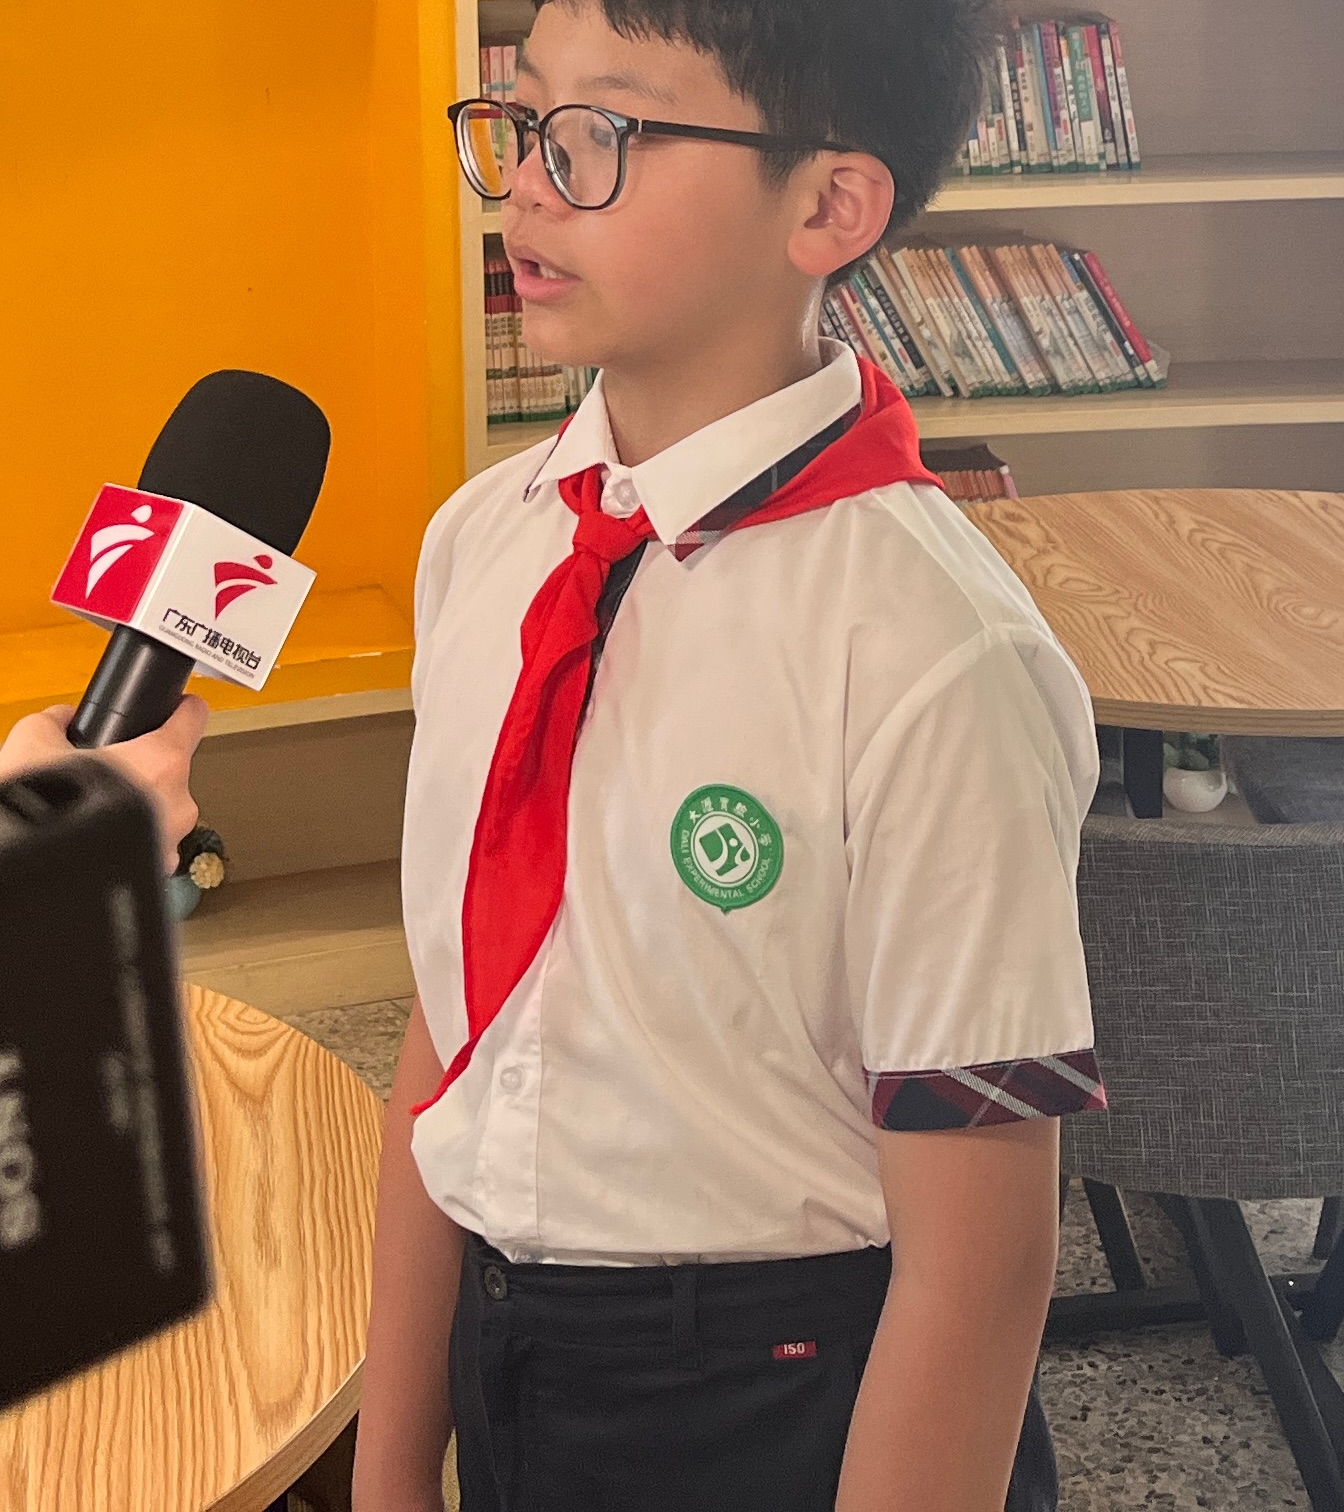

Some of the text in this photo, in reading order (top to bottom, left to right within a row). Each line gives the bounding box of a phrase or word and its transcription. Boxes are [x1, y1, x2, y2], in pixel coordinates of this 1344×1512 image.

[162, 607, 261, 670] 广东广播电视台
[683, 857, 744, 899] EXPERIMENTAL
[746, 857, 771, 893] SCHOOL
[783, 1342, 805, 1355] 150
